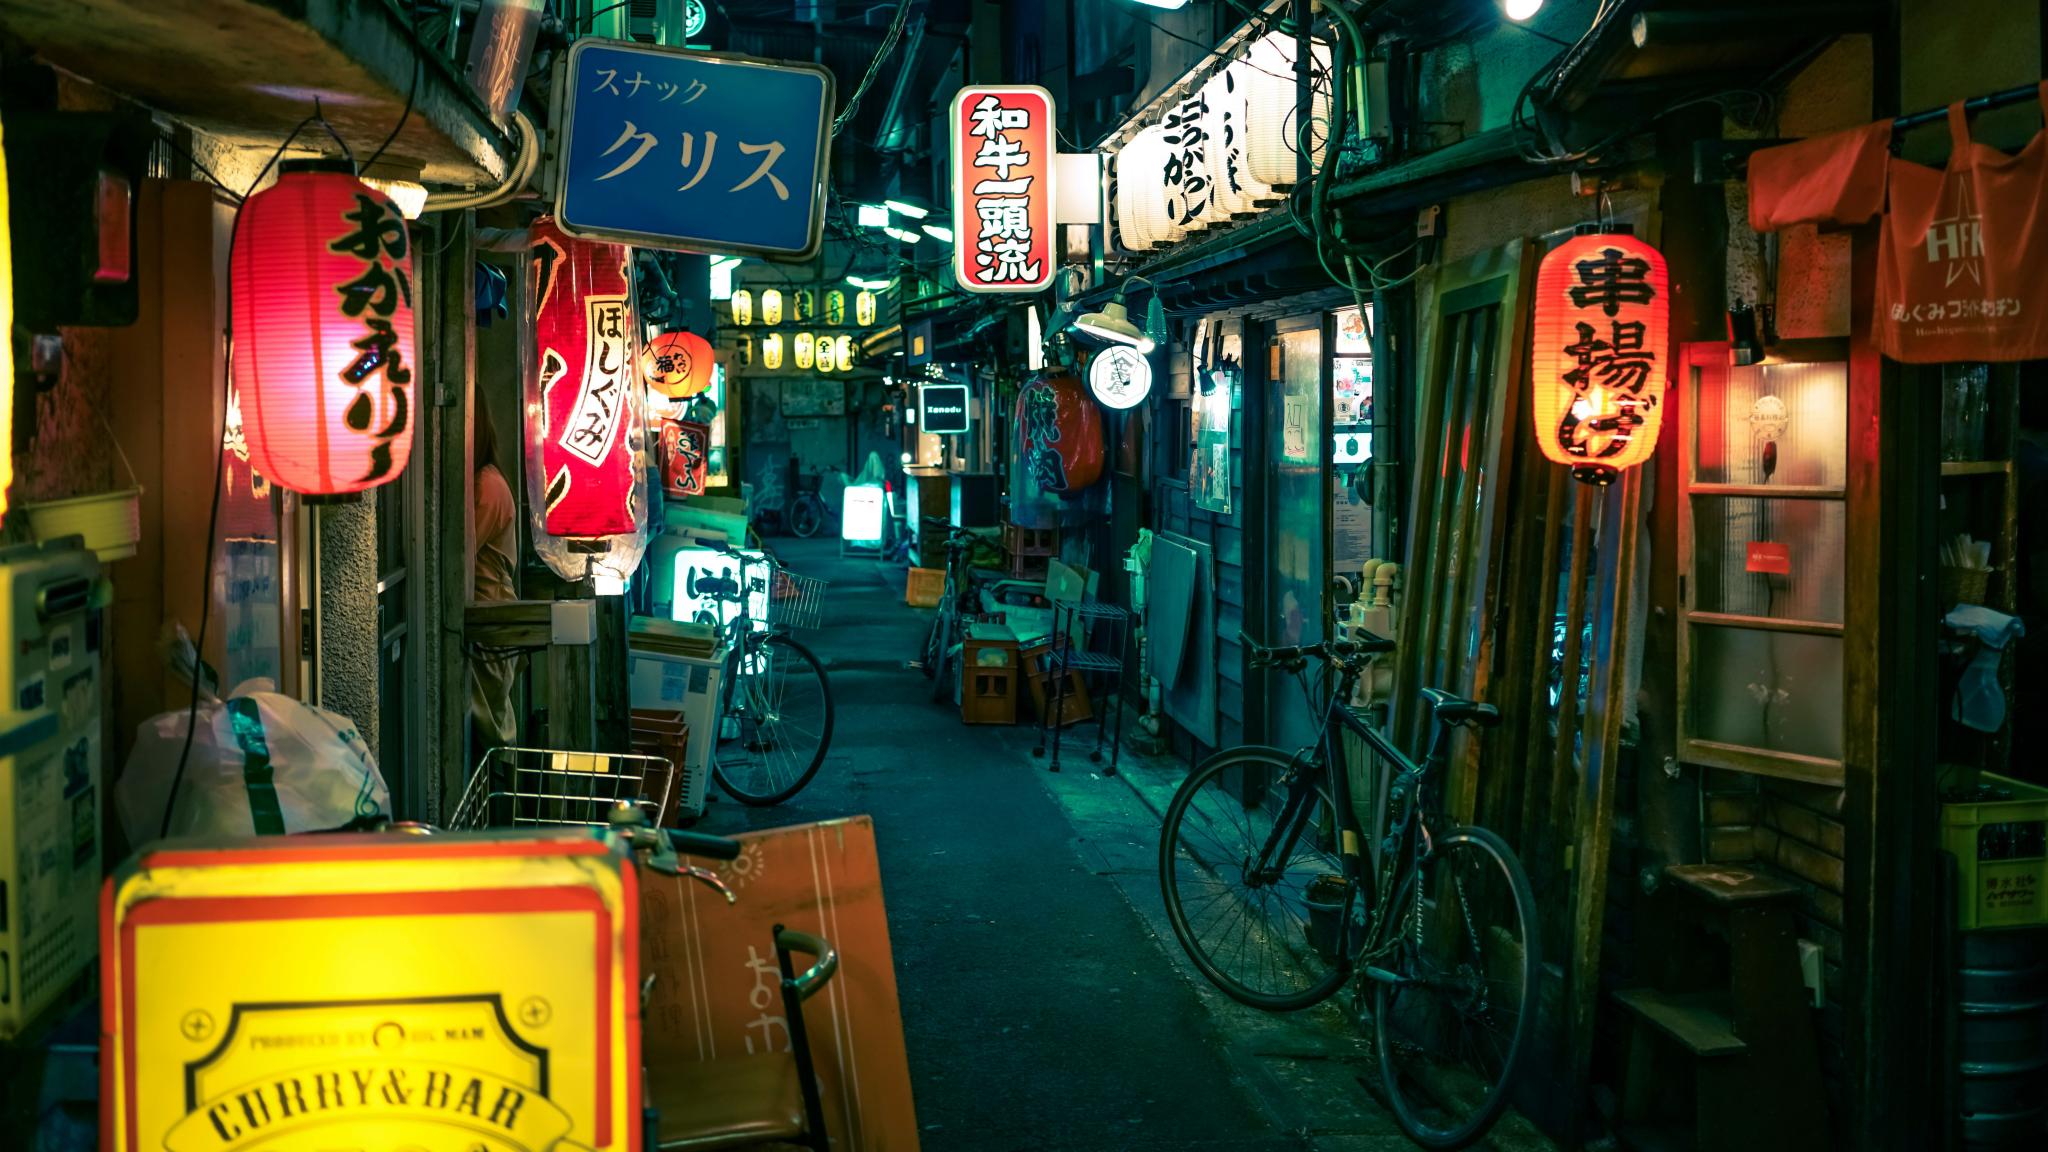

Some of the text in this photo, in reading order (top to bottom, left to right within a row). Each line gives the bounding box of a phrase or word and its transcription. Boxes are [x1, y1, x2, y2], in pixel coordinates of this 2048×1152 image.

[592, 69, 708, 105] スナック
[592, 120, 790, 200] クリス
[970, 95, 1041, 282] 和牛一頭流
[574, 306, 623, 447] ほしぐみ
[1558, 247, 1657, 458] 串揚げ
